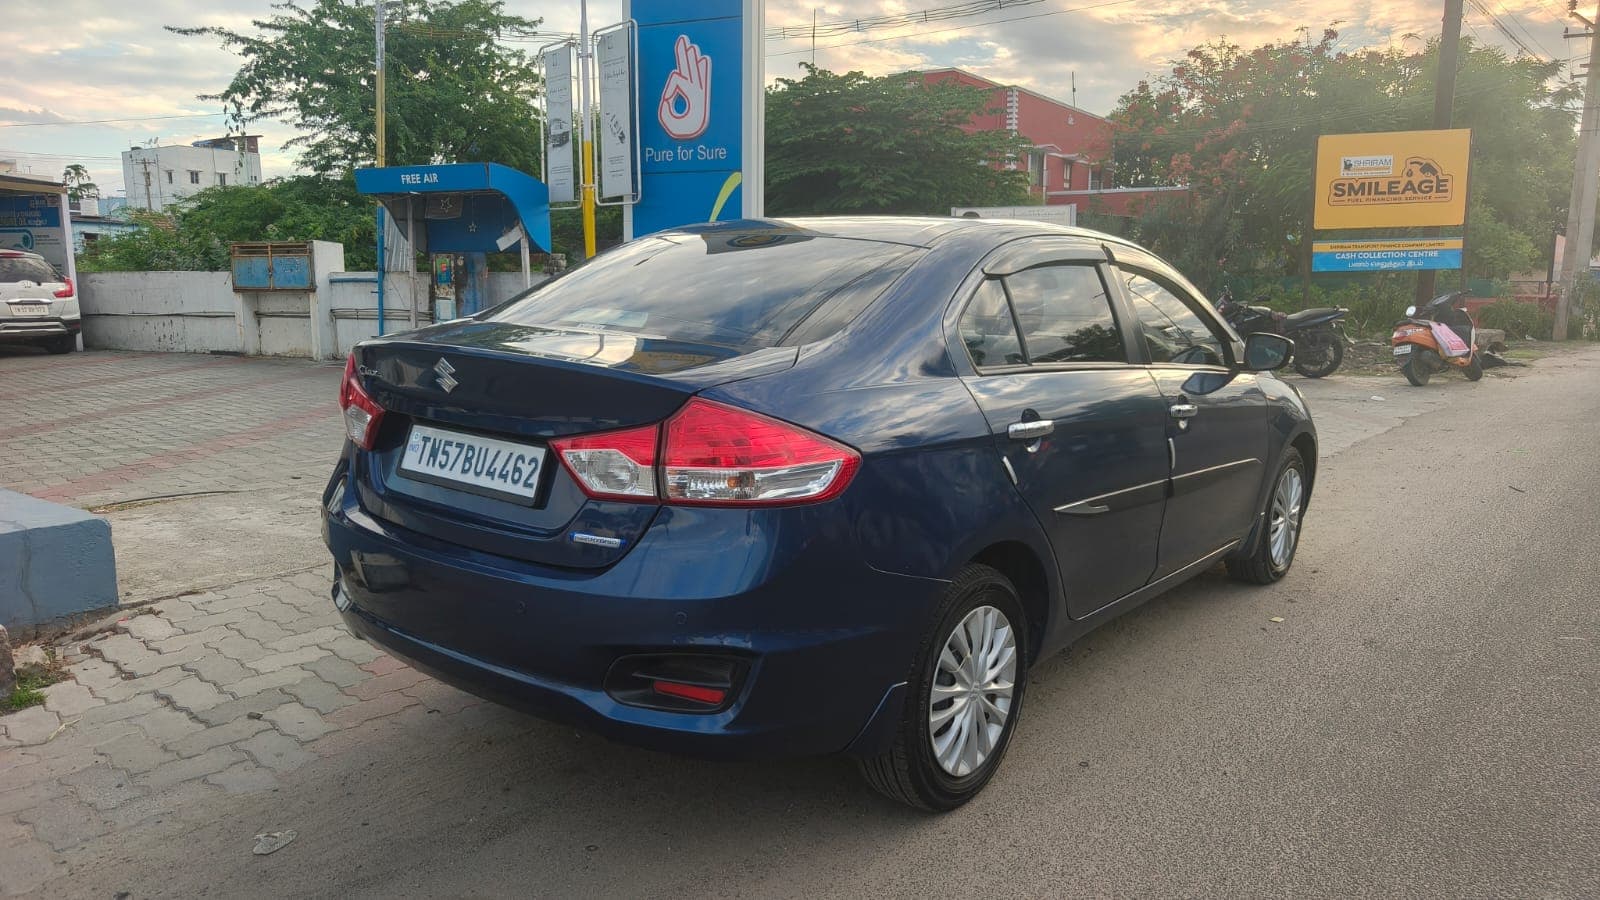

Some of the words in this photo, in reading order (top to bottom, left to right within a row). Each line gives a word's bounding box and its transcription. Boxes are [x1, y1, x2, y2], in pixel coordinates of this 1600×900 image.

[645, 147, 674, 162] Pure
[677, 145, 694, 161] for
[697, 144, 727, 160] Sure
[1353, 158, 1392, 167] SHRIRAM
[401, 174, 421, 184] FREE
[424, 172, 439, 184] AIR
[1333, 178, 1449, 197] SMILEAGE
[1335, 252, 1356, 260] CASH
[1358, 251, 1406, 259] COLLECTION
[1408, 250, 1438, 258] CENTRE
[417, 435, 539, 489] TN57BU4462
